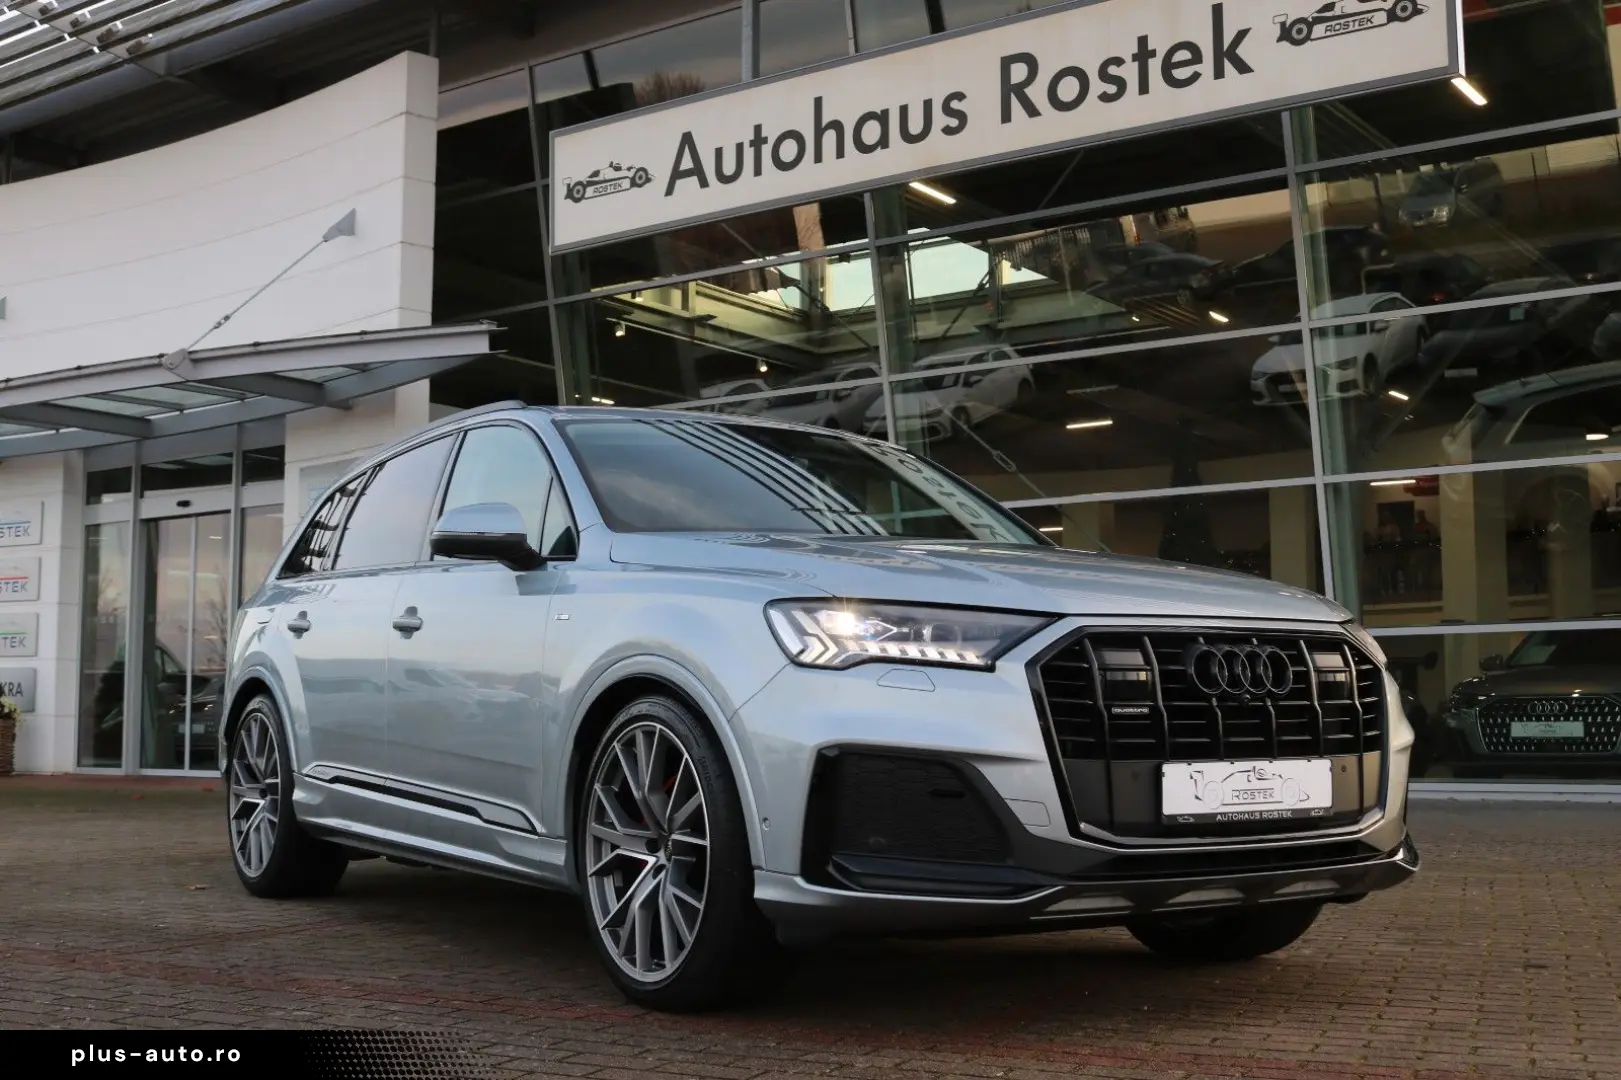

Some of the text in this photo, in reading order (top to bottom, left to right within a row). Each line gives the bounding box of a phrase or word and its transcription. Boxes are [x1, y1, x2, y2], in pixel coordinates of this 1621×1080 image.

[1324, 15, 1375, 35] ROSTEK
[663, 2, 1255, 198] Autohaus Rostek
[593, 181, 623, 194] ROSTEK
[1232, 789, 1276, 801] ROSTEK
[1216, 810, 1293, 822] AUTOHAUS ROSTEK
